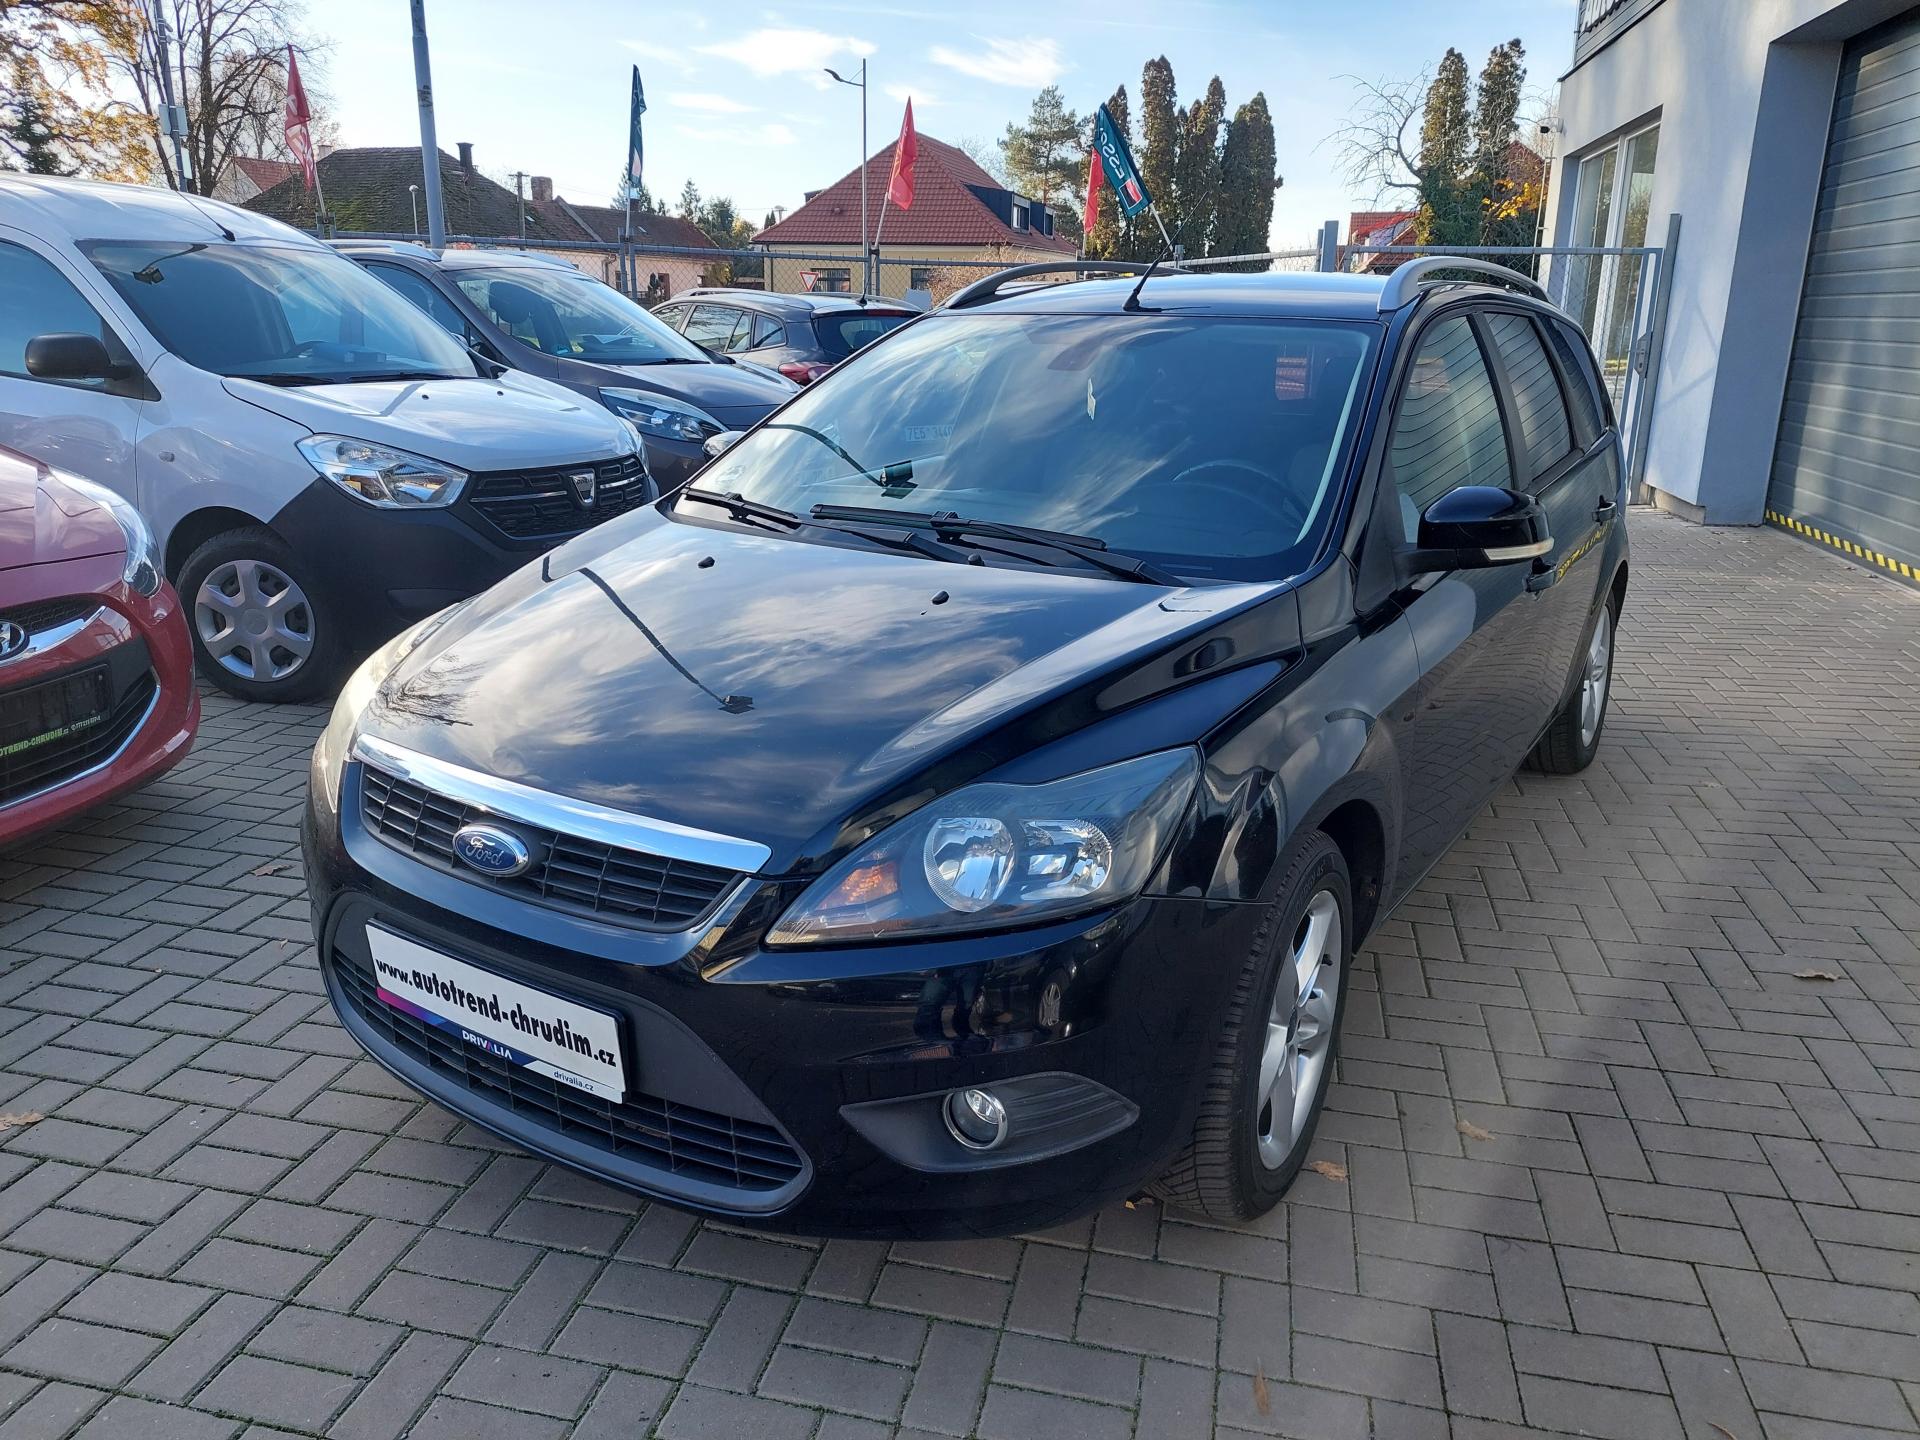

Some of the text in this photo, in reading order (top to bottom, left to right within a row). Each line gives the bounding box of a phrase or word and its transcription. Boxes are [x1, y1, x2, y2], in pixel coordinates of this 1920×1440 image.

[465, 836, 504, 865] Ford
[376, 957, 617, 1068] www.autotrend-chrudim.cz
[461, 1029, 513, 1061] DRIVALIA
[553, 1070, 595, 1092] drivalia.cz
